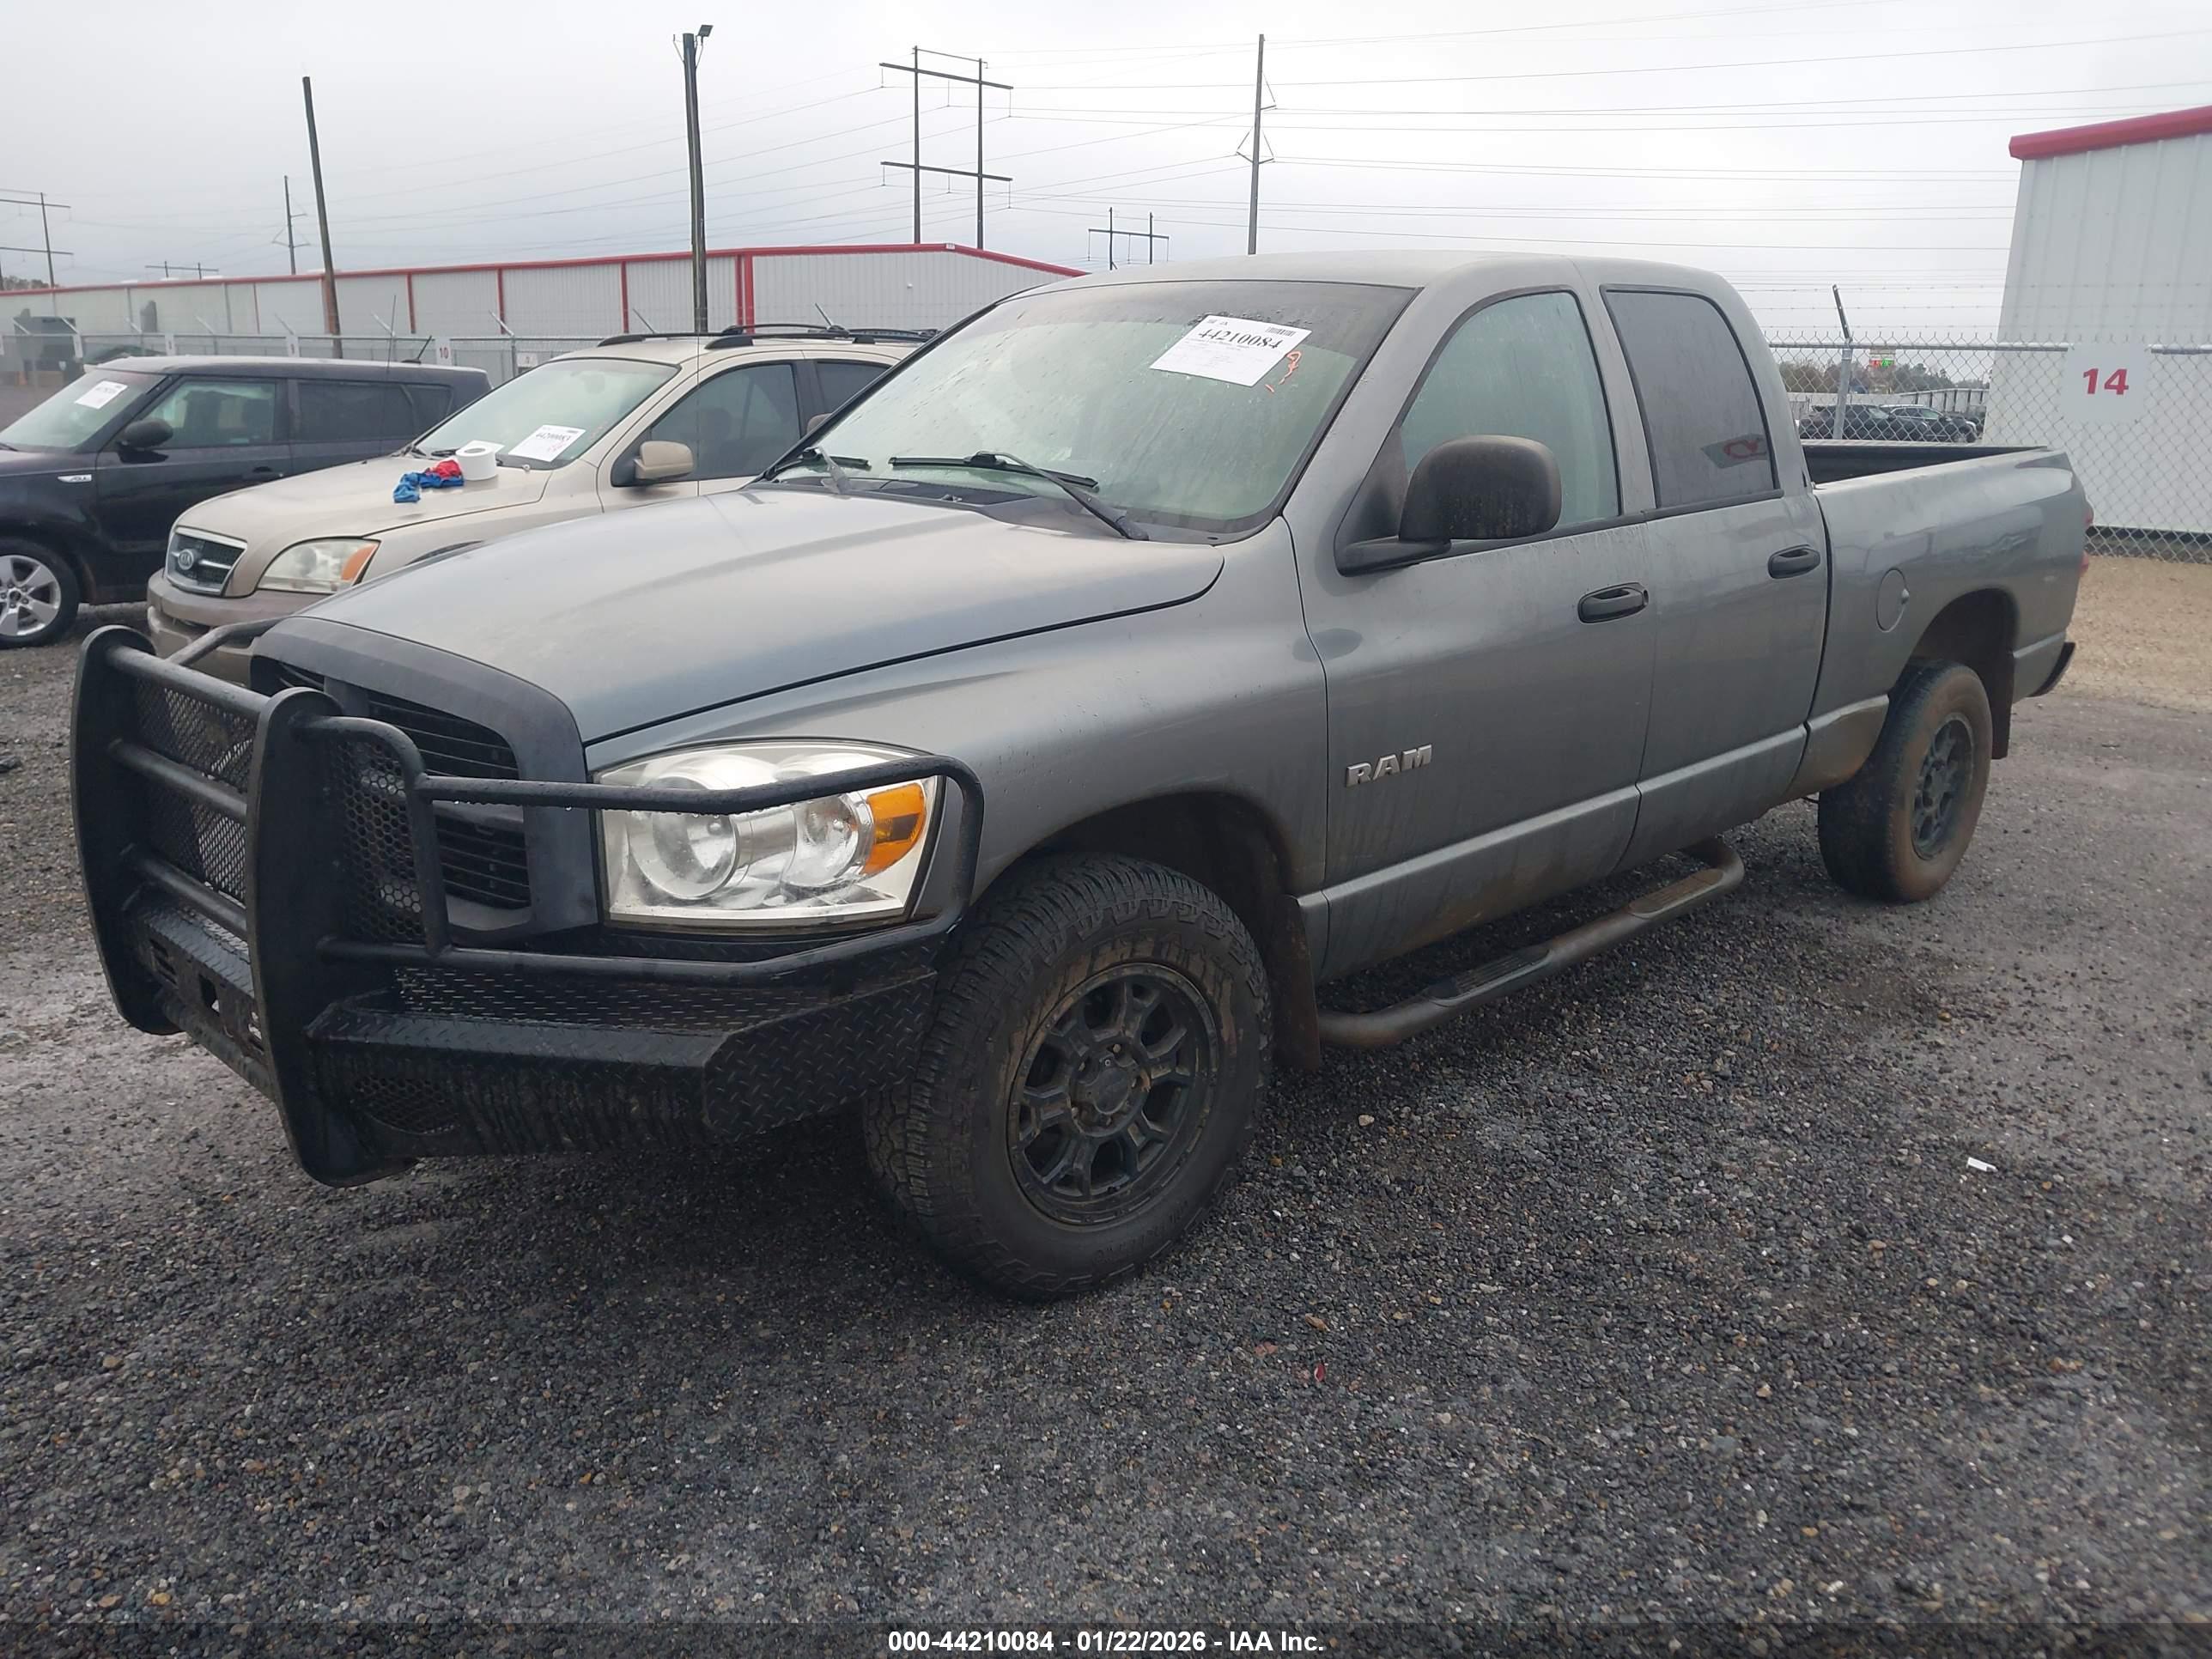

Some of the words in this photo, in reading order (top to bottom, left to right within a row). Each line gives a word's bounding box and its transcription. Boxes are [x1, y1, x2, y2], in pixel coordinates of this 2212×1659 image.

[1198, 329, 1283, 349] 44210084
[439, 347, 449, 359] 10
[2083, 368, 2129, 395] 14
[1346, 744, 1432, 787] RAM
